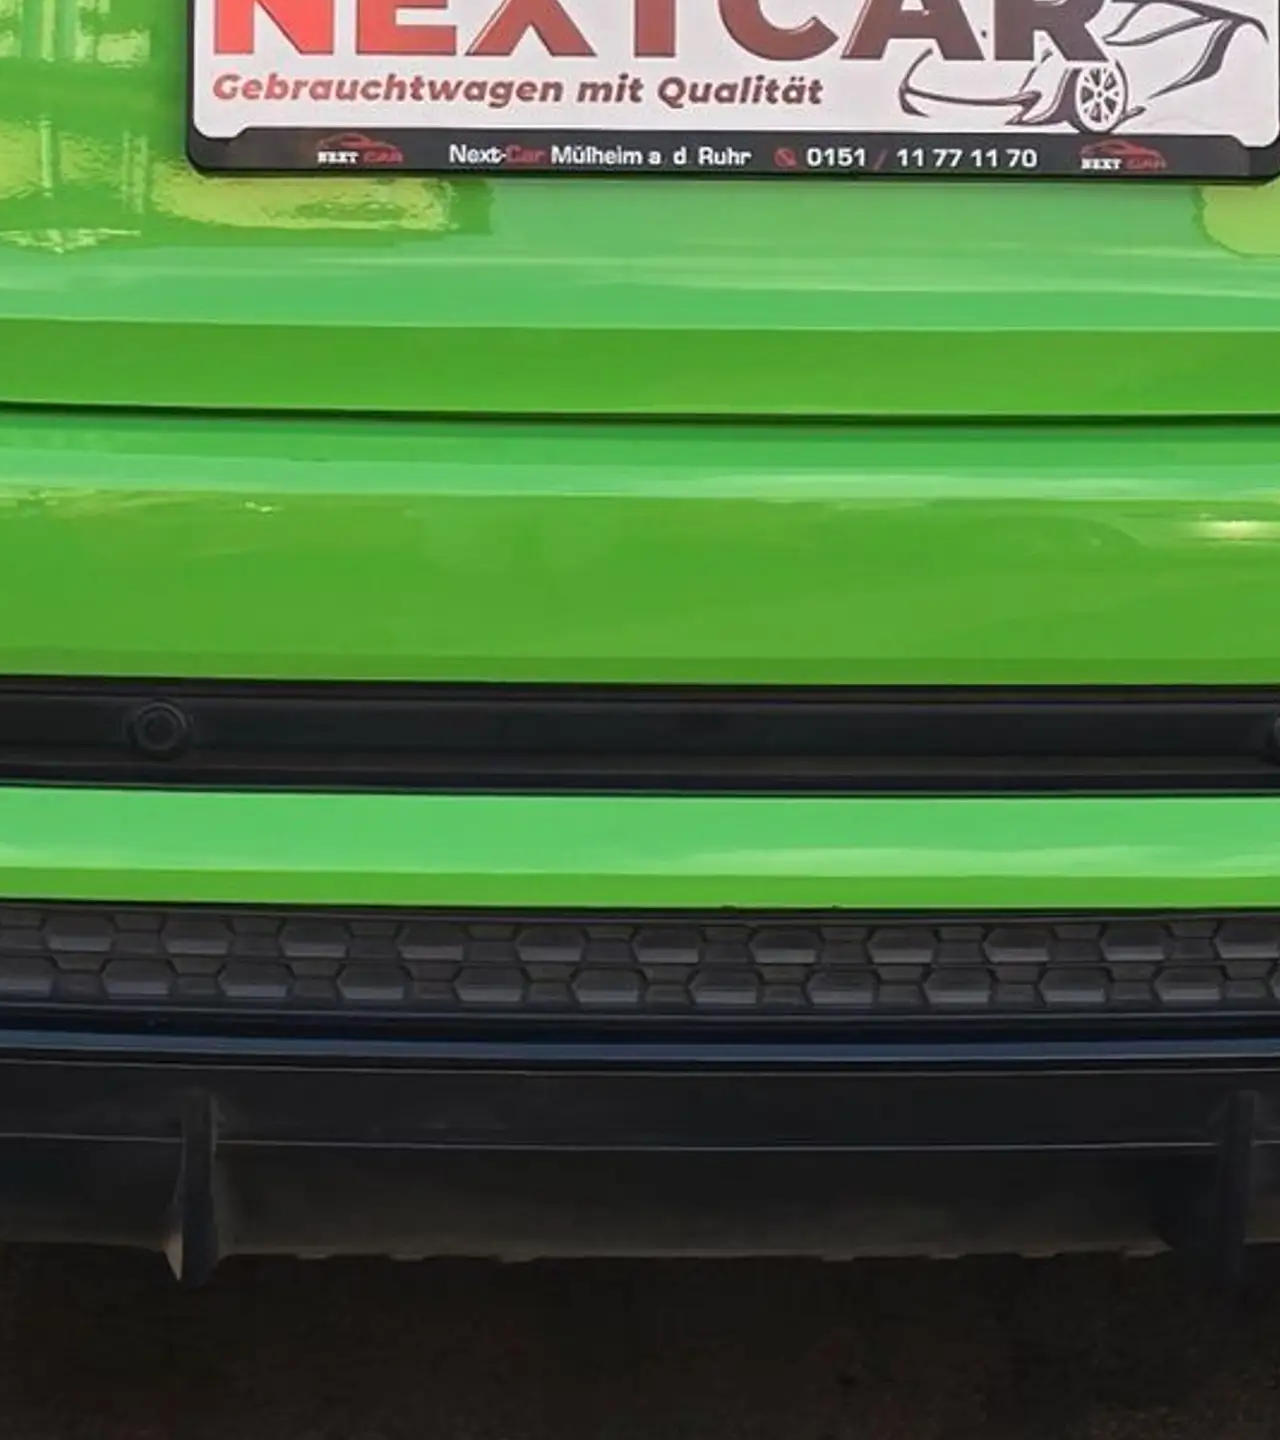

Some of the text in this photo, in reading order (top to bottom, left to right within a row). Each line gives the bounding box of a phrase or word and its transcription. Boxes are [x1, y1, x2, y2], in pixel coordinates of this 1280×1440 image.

[212, 72, 824, 109] Gebrauchtwagen mit Qualität
[551, 145, 642, 165] Mülheim
[697, 146, 753, 166] Ruhr
[805, 147, 866, 167] 0151
